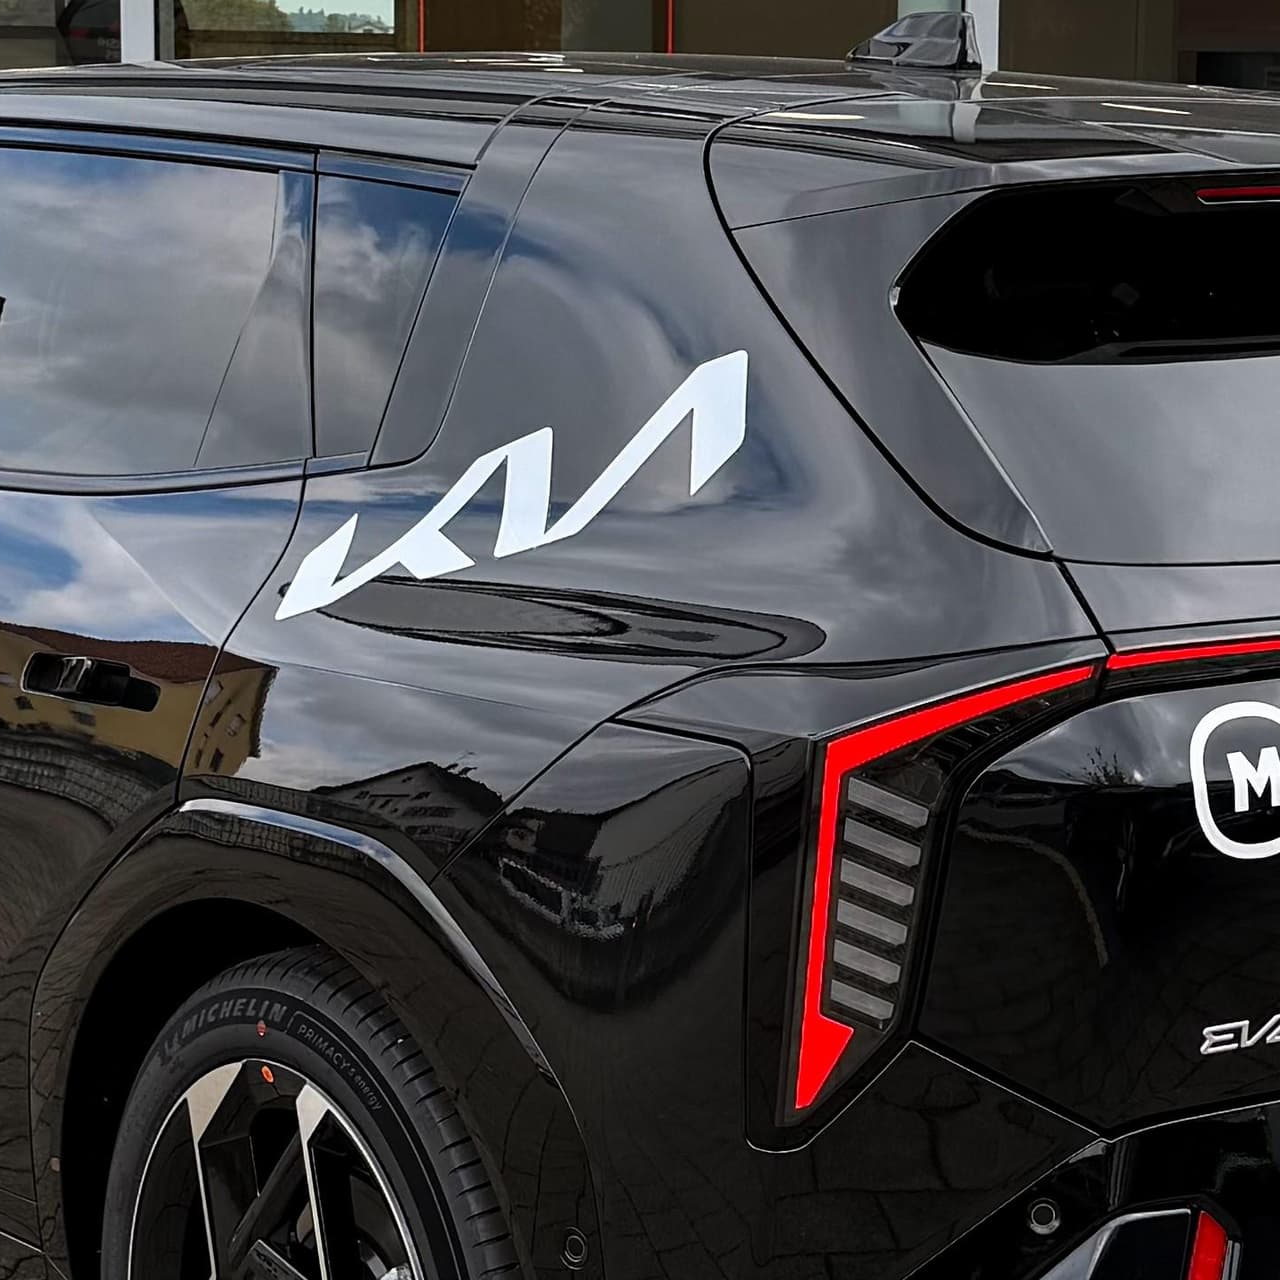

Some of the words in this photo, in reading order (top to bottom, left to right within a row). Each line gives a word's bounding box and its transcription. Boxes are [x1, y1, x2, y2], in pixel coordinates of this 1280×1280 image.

[274, 350, 749, 621] KIA
[181, 998, 288, 1039] MICHELIN
[297, 1023, 351, 1070] PRIMACY
[353, 1075, 383, 1111] energy
